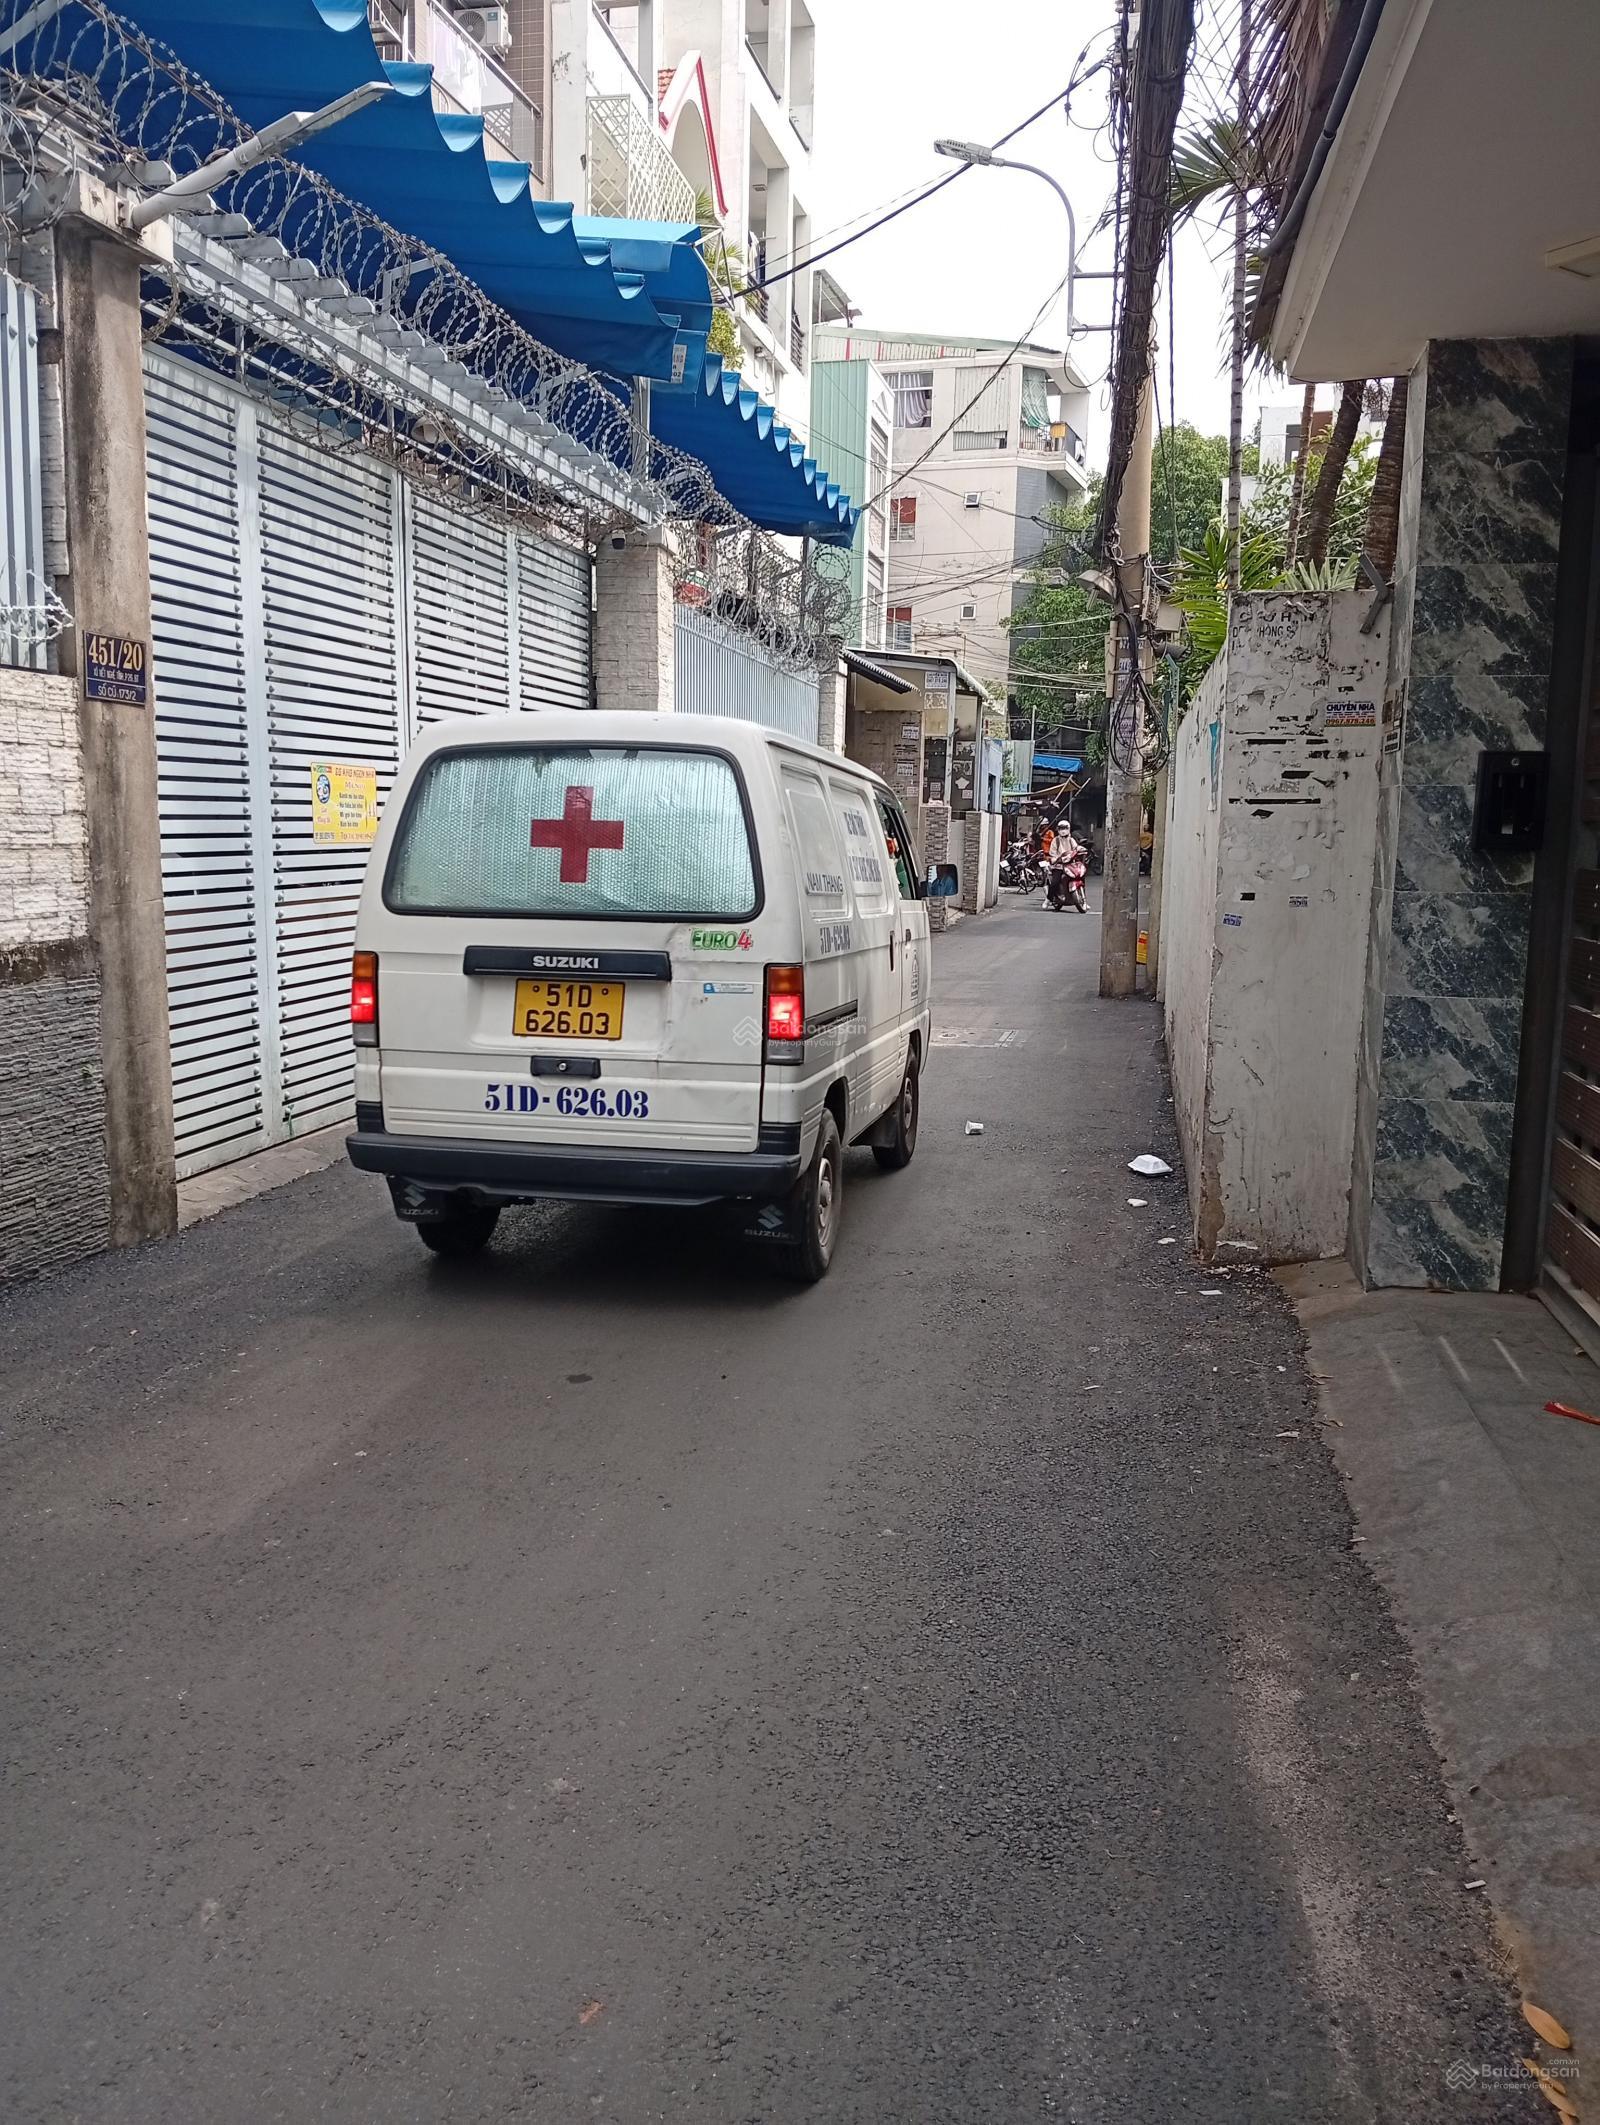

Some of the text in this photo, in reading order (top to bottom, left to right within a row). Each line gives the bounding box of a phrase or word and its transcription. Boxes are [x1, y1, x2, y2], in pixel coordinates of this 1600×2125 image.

[88, 635, 143, 671] 451/20
[533, 955, 599, 969] SUZUKI
[546, 984, 593, 1008] 51D
[525, 1009, 610, 1035] 626.03
